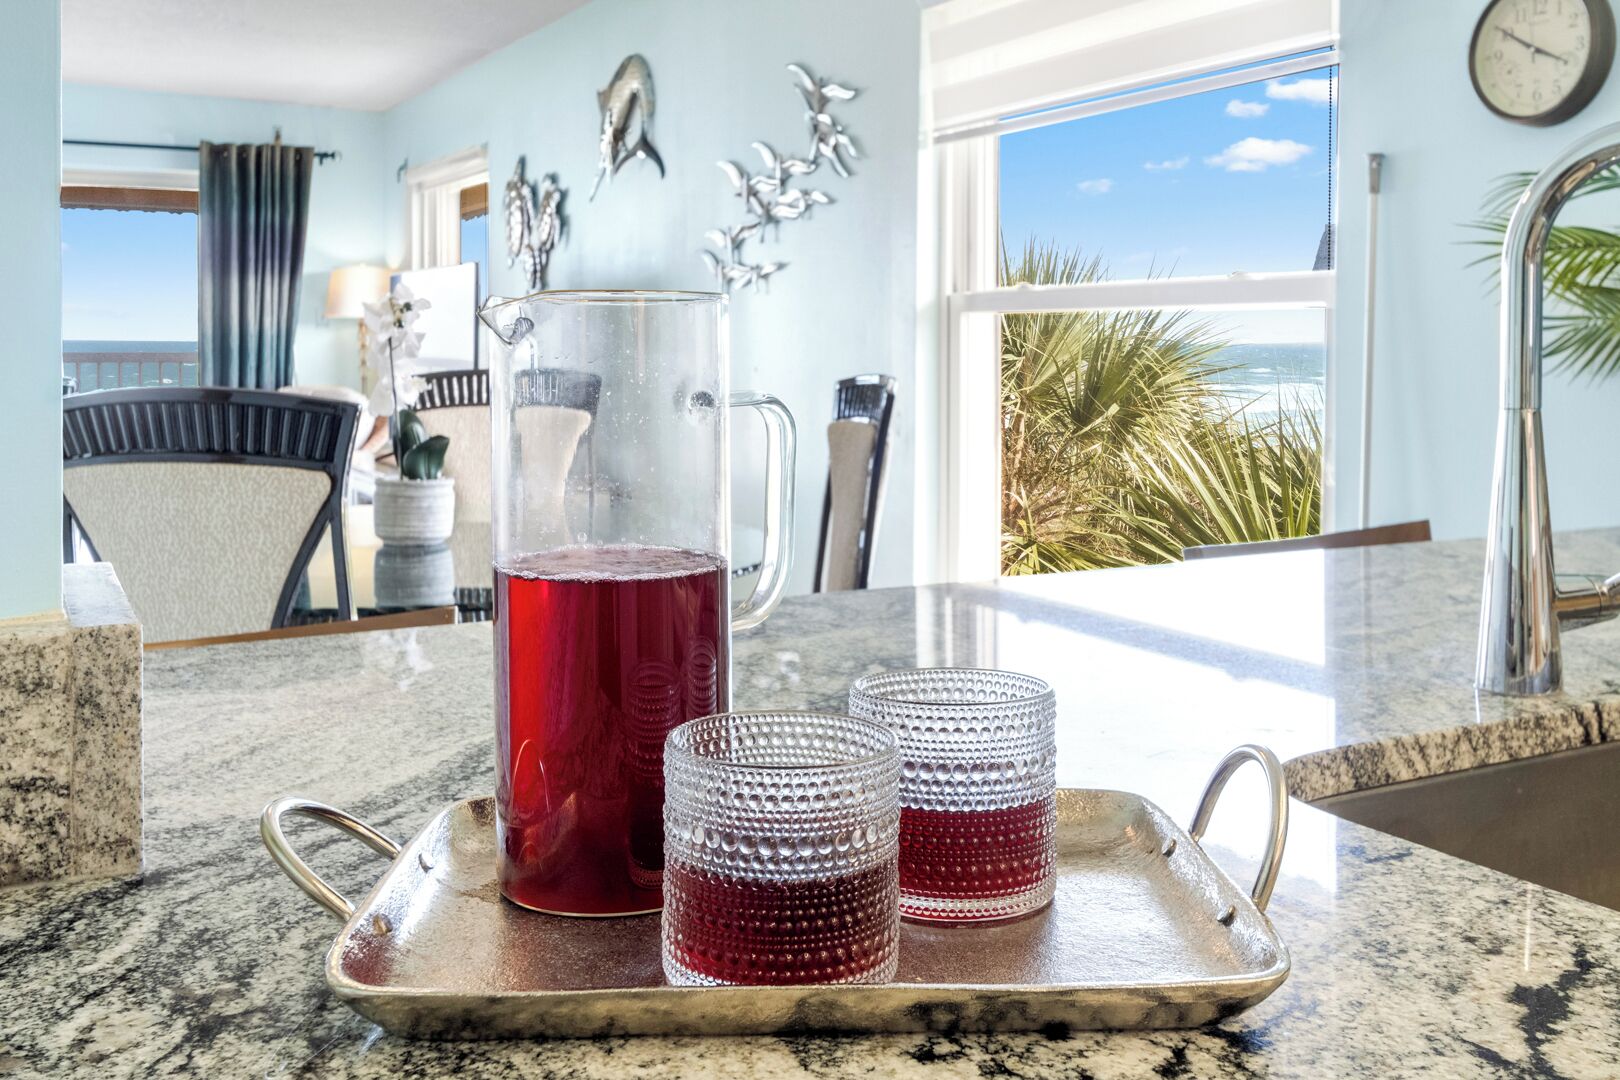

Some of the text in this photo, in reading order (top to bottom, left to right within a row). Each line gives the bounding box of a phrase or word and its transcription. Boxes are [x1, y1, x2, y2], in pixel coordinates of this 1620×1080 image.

[1568, 12, 1579, 28] 2
[1575, 35, 1586, 51] 3
[1493, 49, 1504, 63] 9
